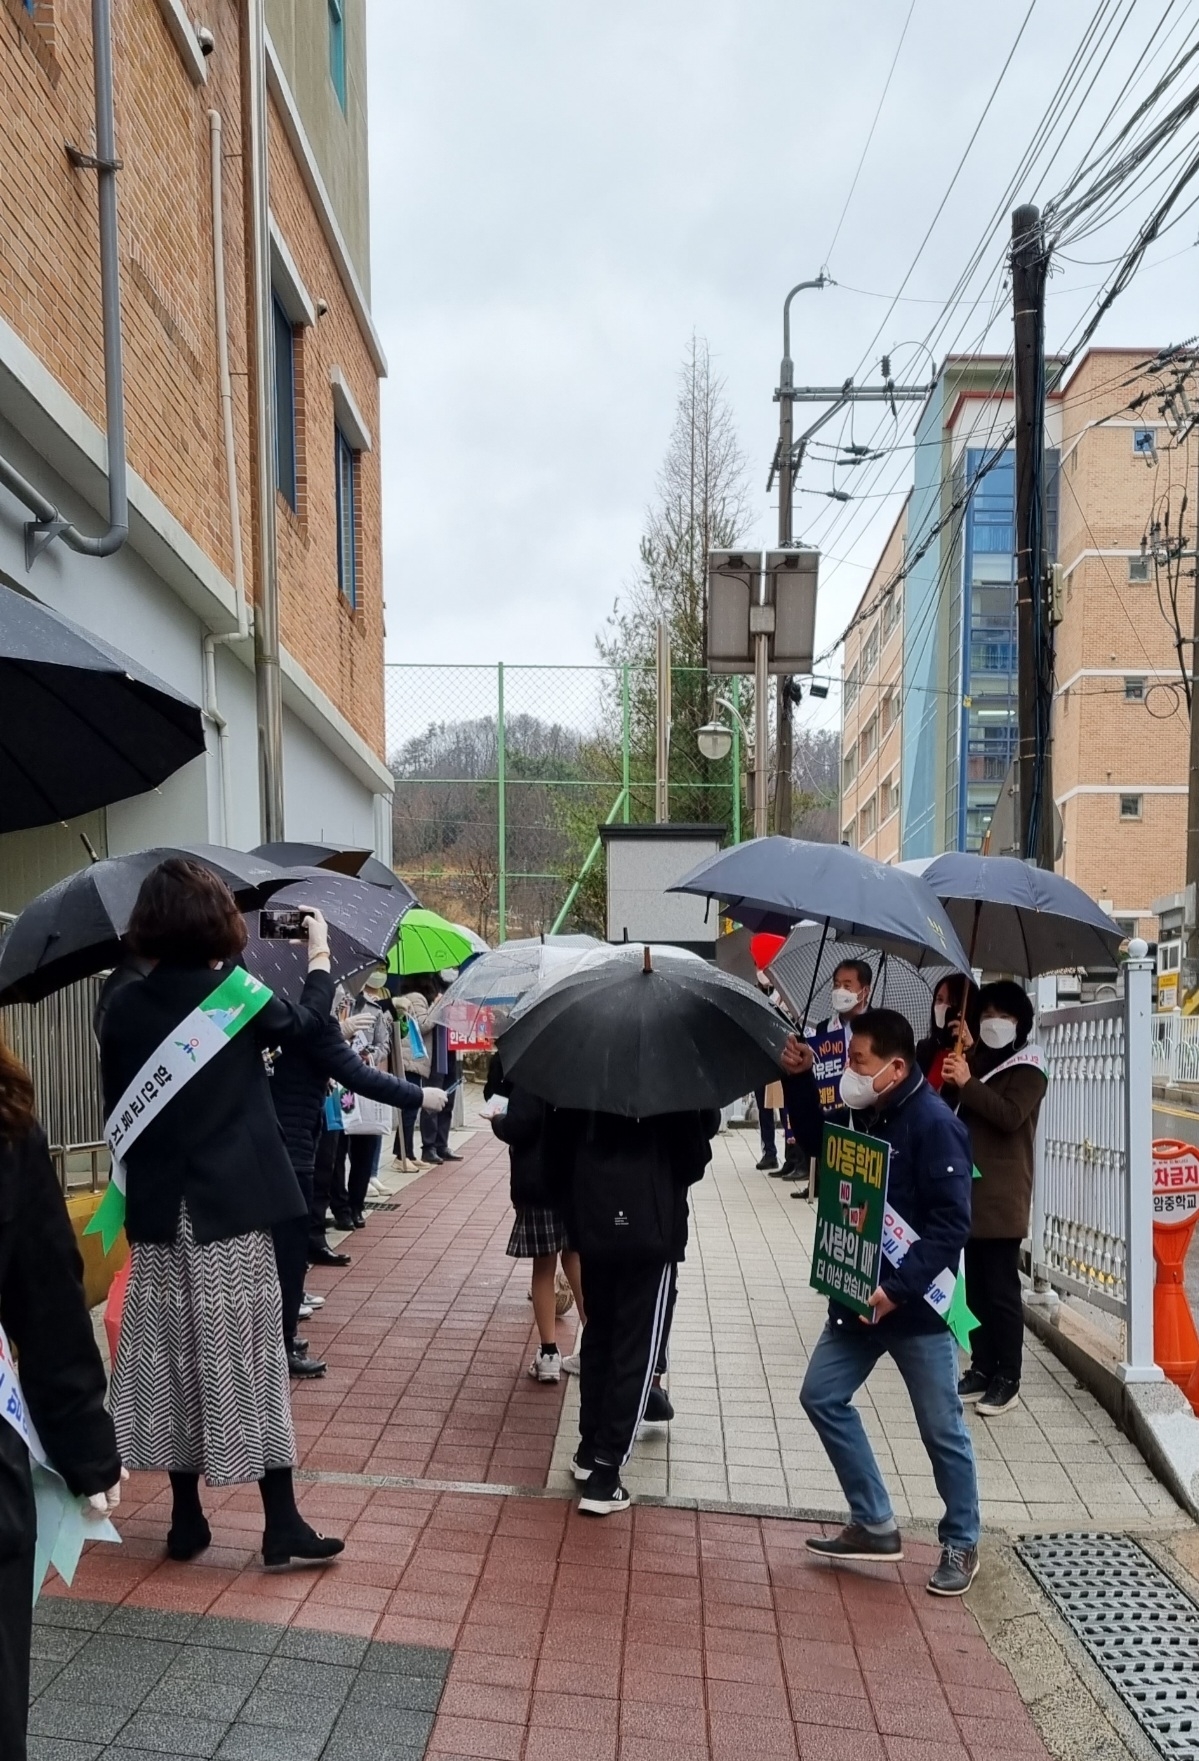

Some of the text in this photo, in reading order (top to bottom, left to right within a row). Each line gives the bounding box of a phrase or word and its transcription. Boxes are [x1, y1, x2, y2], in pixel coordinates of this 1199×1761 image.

[819, 1041, 844, 1057] NO NO
[827, 1136, 884, 1189] 아동학대
[841, 1183, 850, 1201] NO
[816, 1259, 826, 1282] 더
[826, 1263, 843, 1290] 이상
